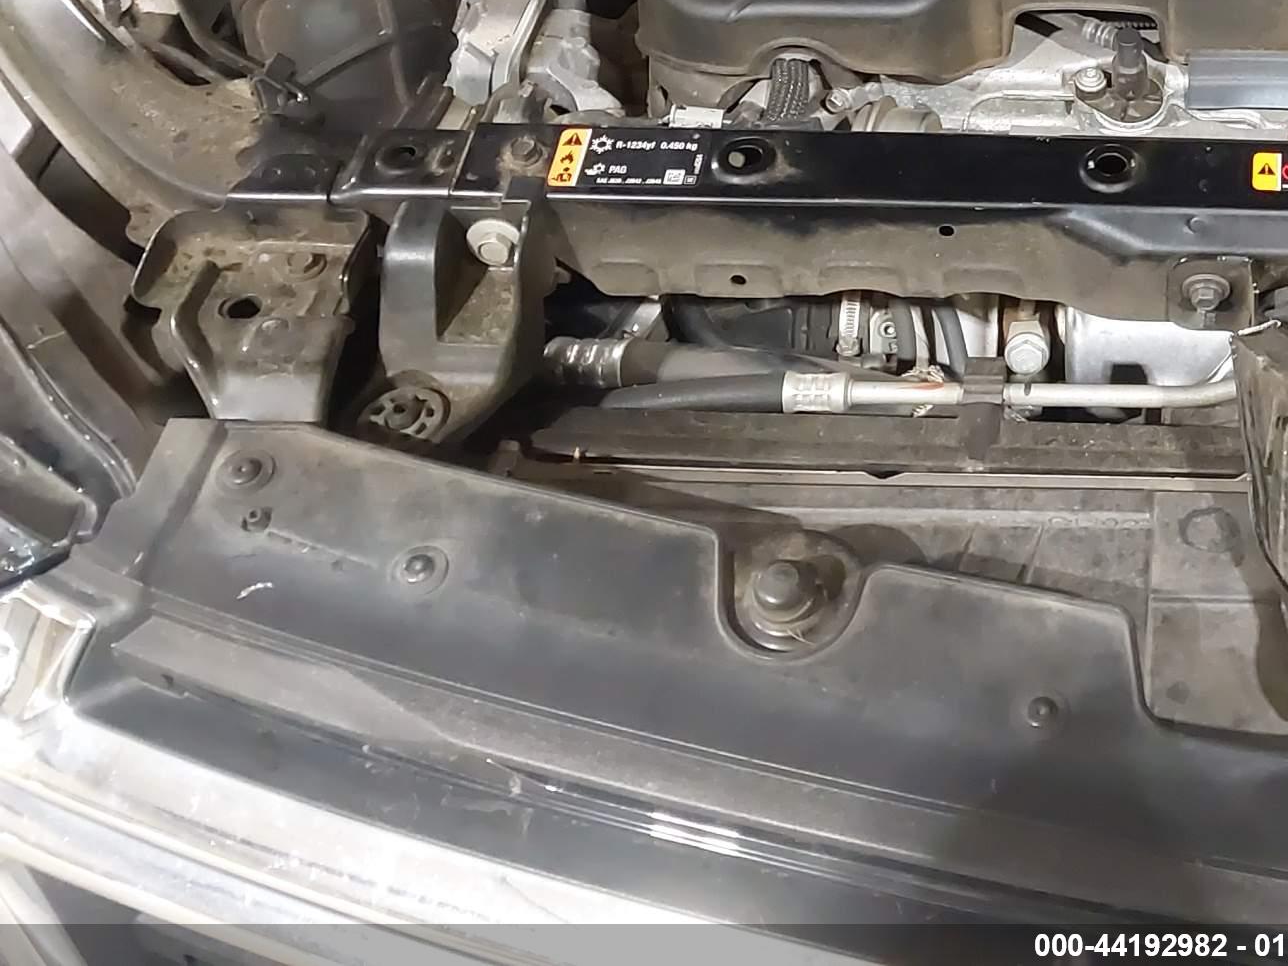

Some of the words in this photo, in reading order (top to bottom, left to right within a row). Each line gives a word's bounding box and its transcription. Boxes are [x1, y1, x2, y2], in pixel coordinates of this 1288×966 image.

[615, 140, 657, 151] R-1234yf
[660, 141, 685, 150] 0.450
[685, 141, 698, 151] kg
